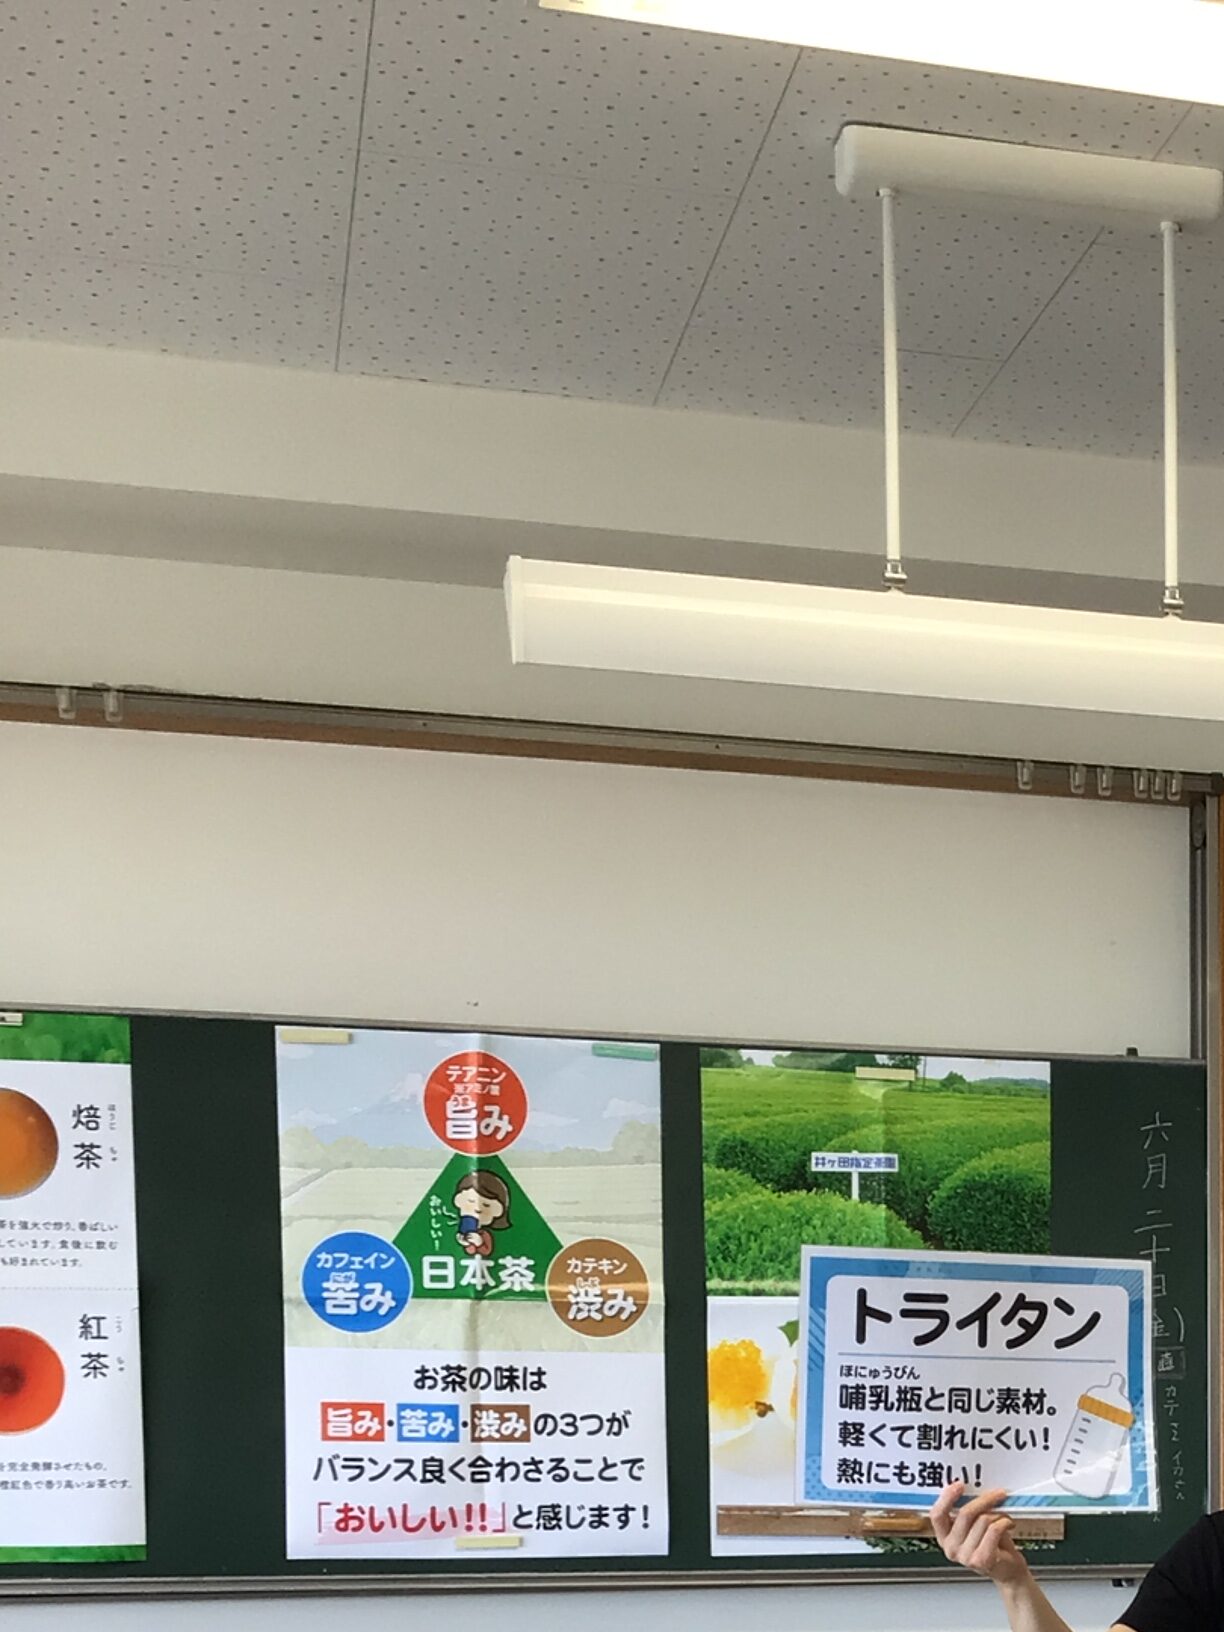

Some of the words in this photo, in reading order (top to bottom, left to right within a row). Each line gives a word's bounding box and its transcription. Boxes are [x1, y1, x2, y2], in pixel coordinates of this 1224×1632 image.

[446, 1065, 507, 1083] テアニン
[445, 1098, 513, 1140] 旨み
[316, 1252, 396, 1270] カフェイン
[422, 1254, 535, 1293] 日本茶
[567, 1257, 628, 1275] カテキン
[322, 1279, 396, 1316] 苦み
[567, 1281, 637, 1322] 渋み
[857, 1287, 1101, 1350] トライタン
[79, 1314, 109, 1379] 紅茶
[413, 1364, 547, 1393] お茶の味は
[840, 1365, 920, 1380] ほにゅうびん
[839, 1384, 1056, 1416] 哺乳瓶と同じ素材。
[838, 1421, 1050, 1450] 軽くて割れにくい!
[313, 1454, 645, 1484] バランス良く合わさることで
[837, 1458, 982, 1488] 熱にも強い!
[317, 1502, 650, 1534] 「おいしい!!」と感じます!
